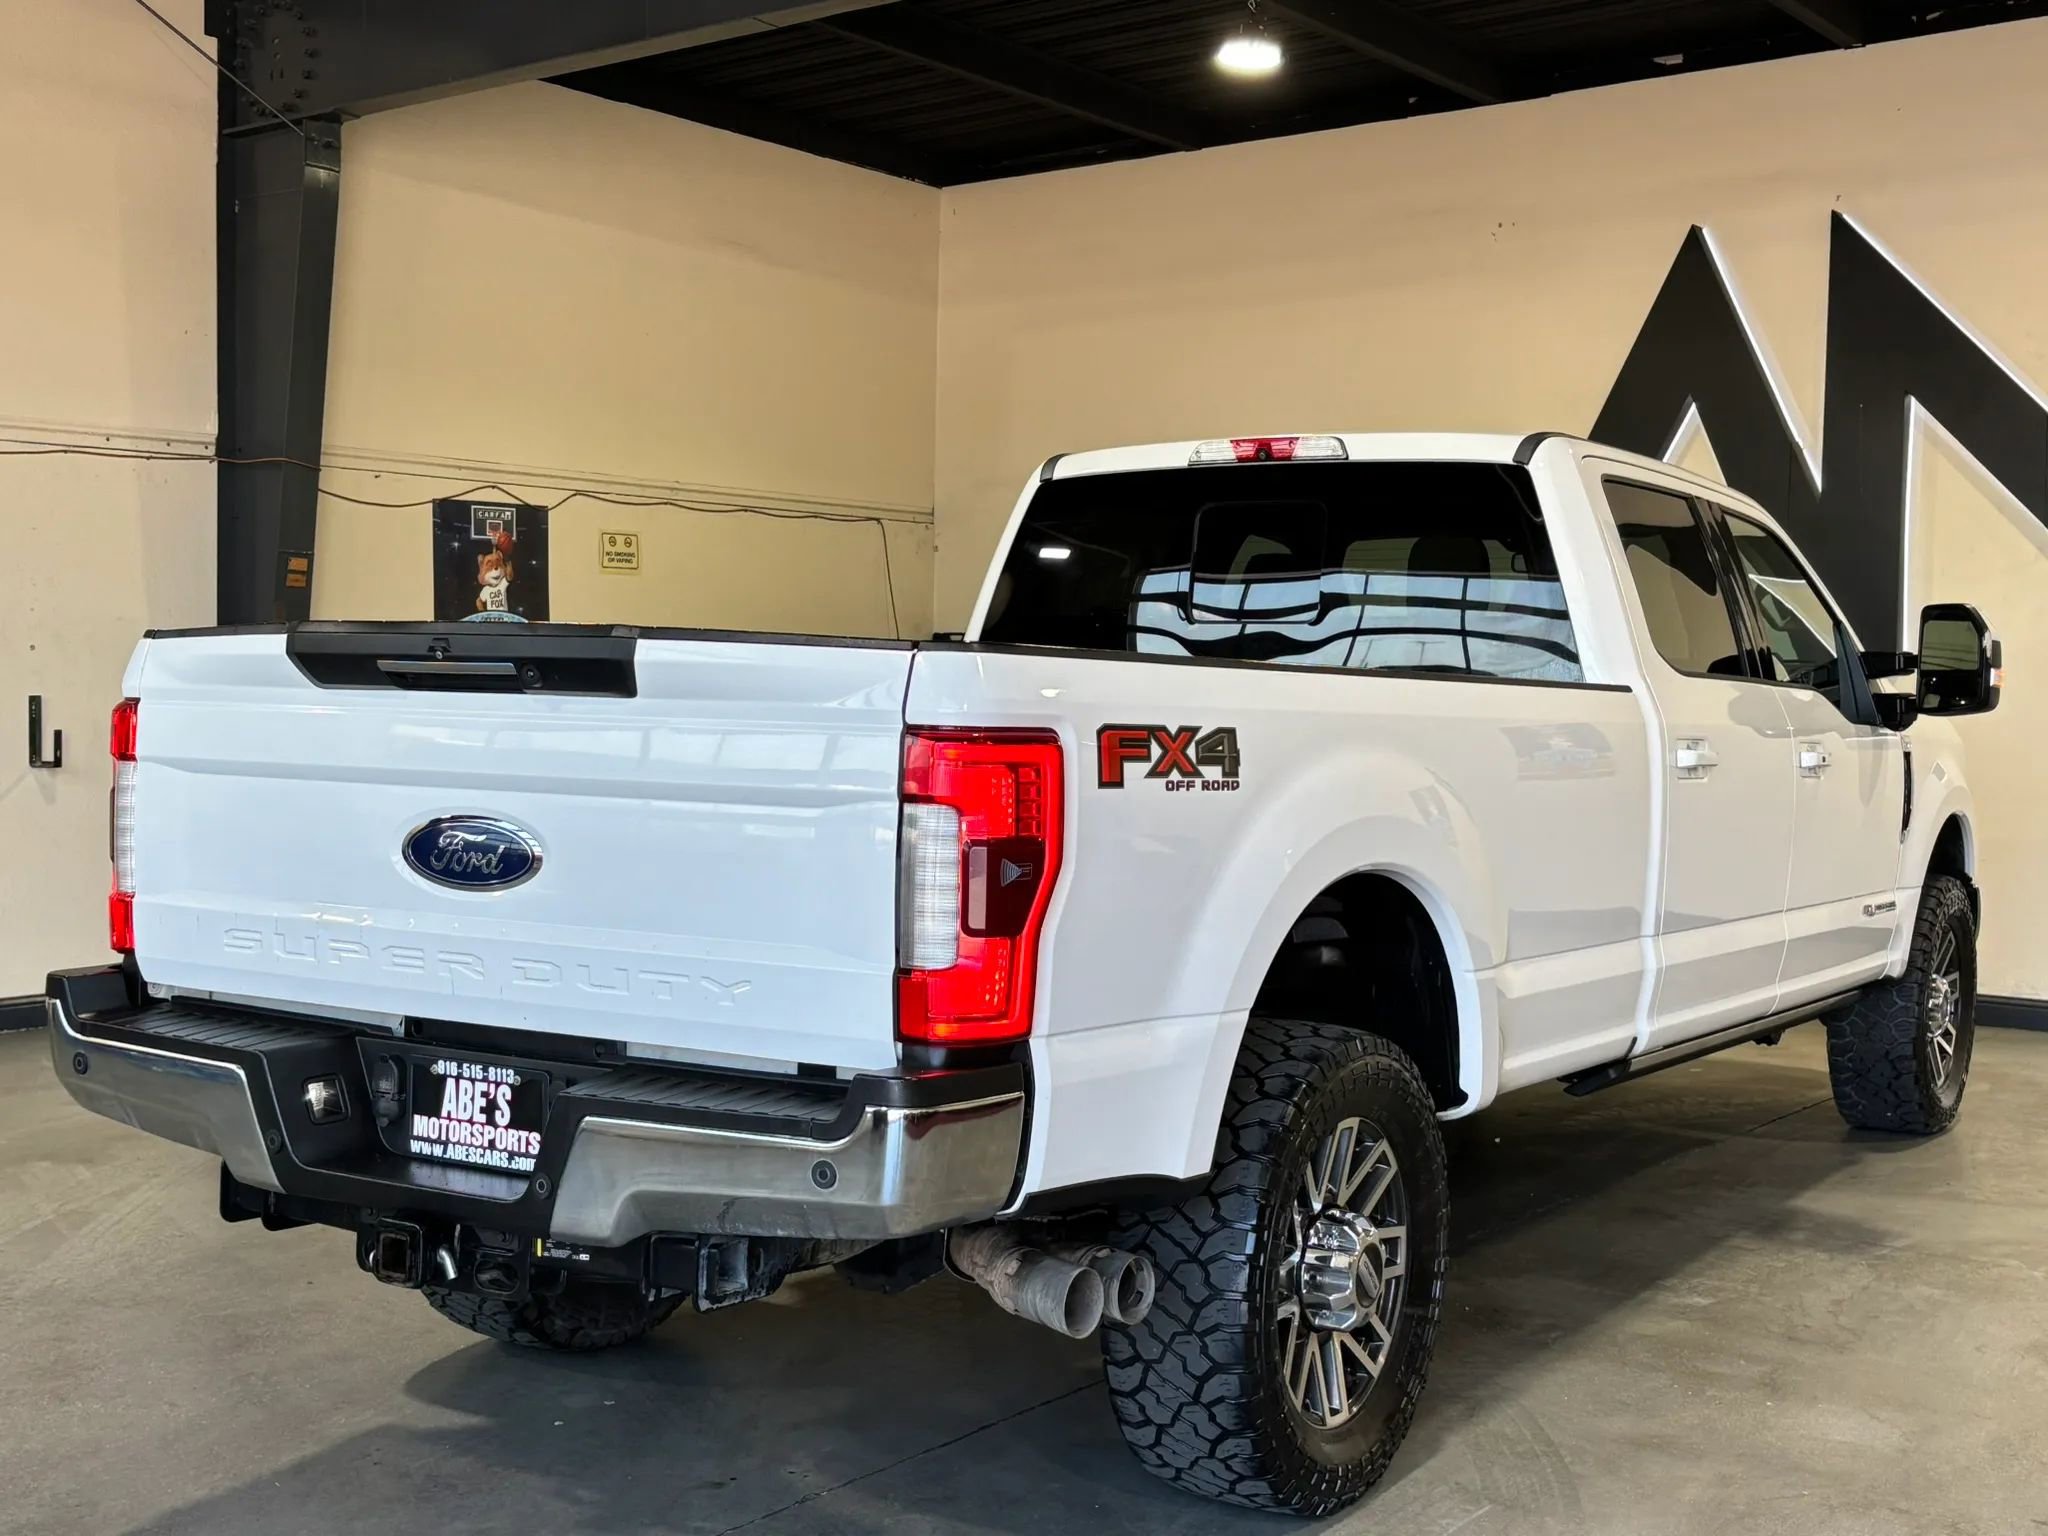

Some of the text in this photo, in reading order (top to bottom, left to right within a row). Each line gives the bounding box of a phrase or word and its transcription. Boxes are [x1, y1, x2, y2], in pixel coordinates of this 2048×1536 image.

[489, 589, 503, 599] CAR
[490, 599, 504, 609] FOX
[1096, 723, 1241, 789] FX4
[1165, 780, 1240, 792] OFF ROAD
[429, 830, 506, 875] Ford
[223, 927, 753, 1007] SUPER DUTY
[436, 1059, 515, 1085] 916-515-8113
[440, 1076, 512, 1128] ABE'S
[412, 1113, 542, 1156] MOTORSPORTS
